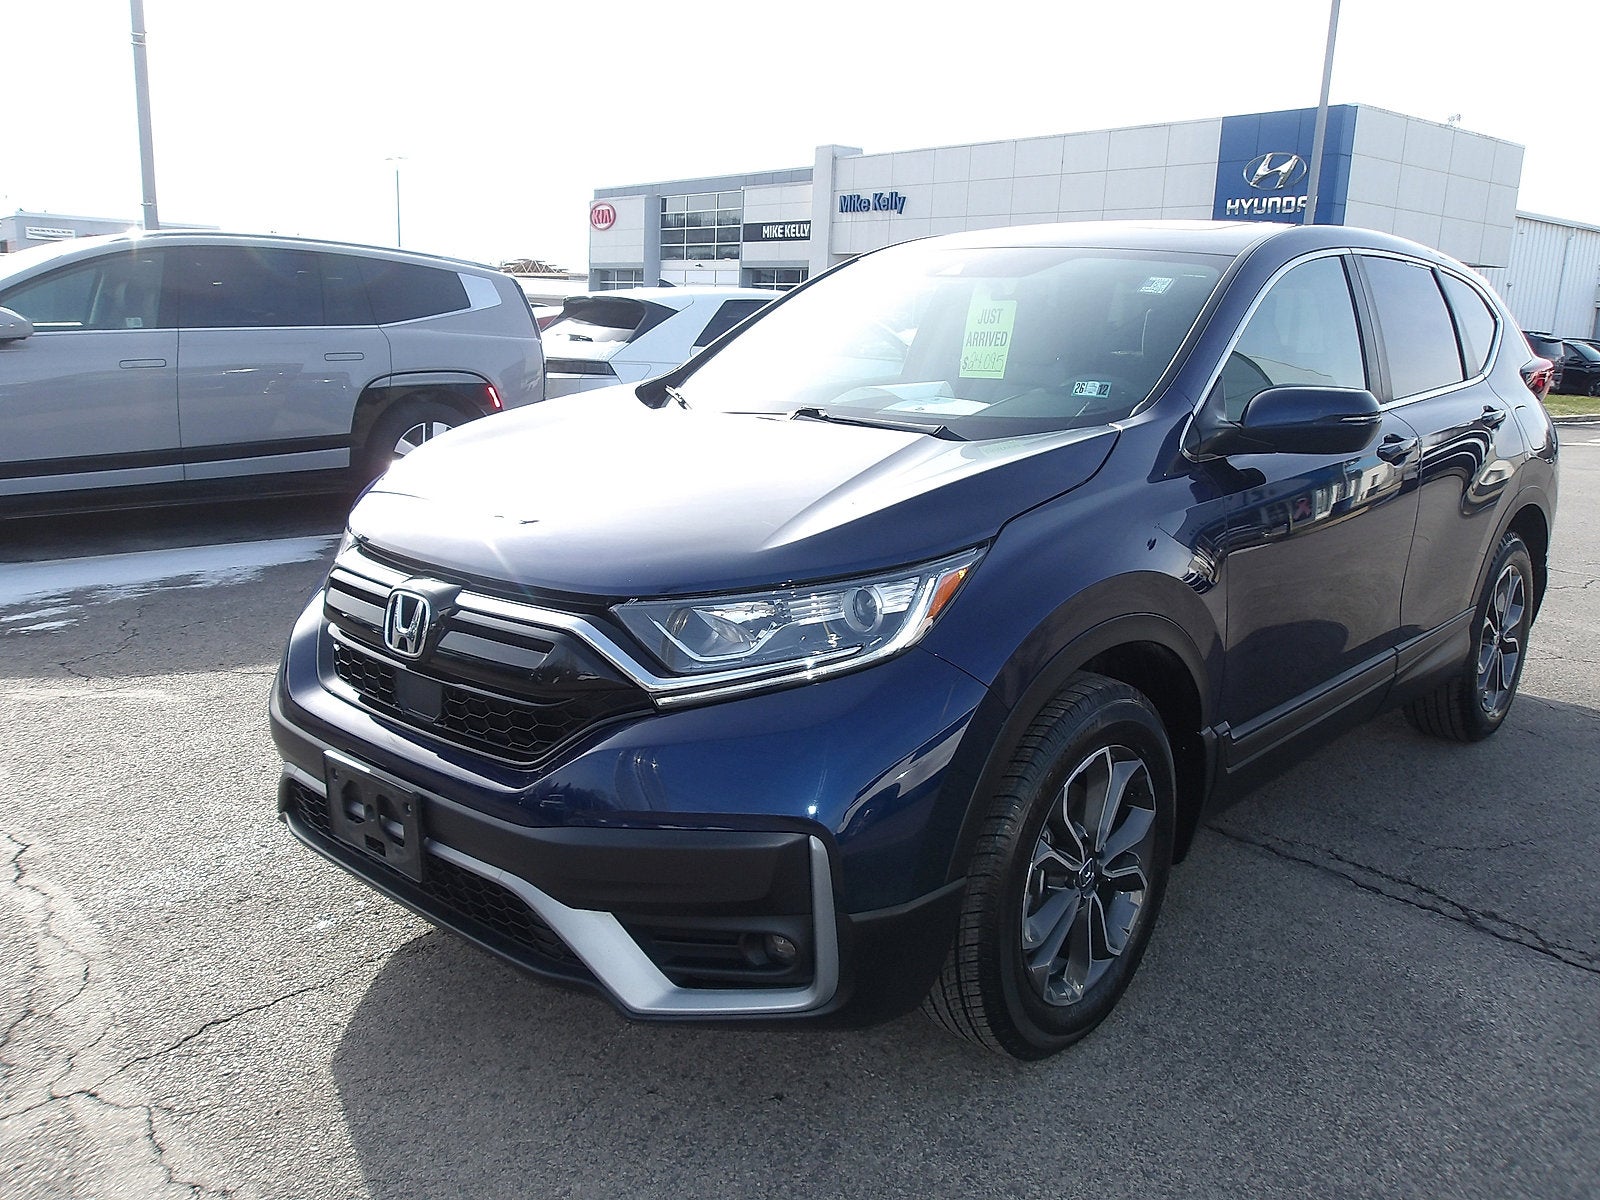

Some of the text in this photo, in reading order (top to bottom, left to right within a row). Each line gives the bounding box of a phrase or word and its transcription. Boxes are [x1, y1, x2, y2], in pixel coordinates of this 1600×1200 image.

[838, 191, 907, 215] Mike Kelly
[592, 208, 612, 225] KIA
[762, 222, 811, 239] MIKE KELLY
[977, 308, 1003, 325] JUST
[965, 331, 1008, 347] ARRIVED
[1074, 382, 1086, 394] 26
[1097, 384, 1110, 396] 12
